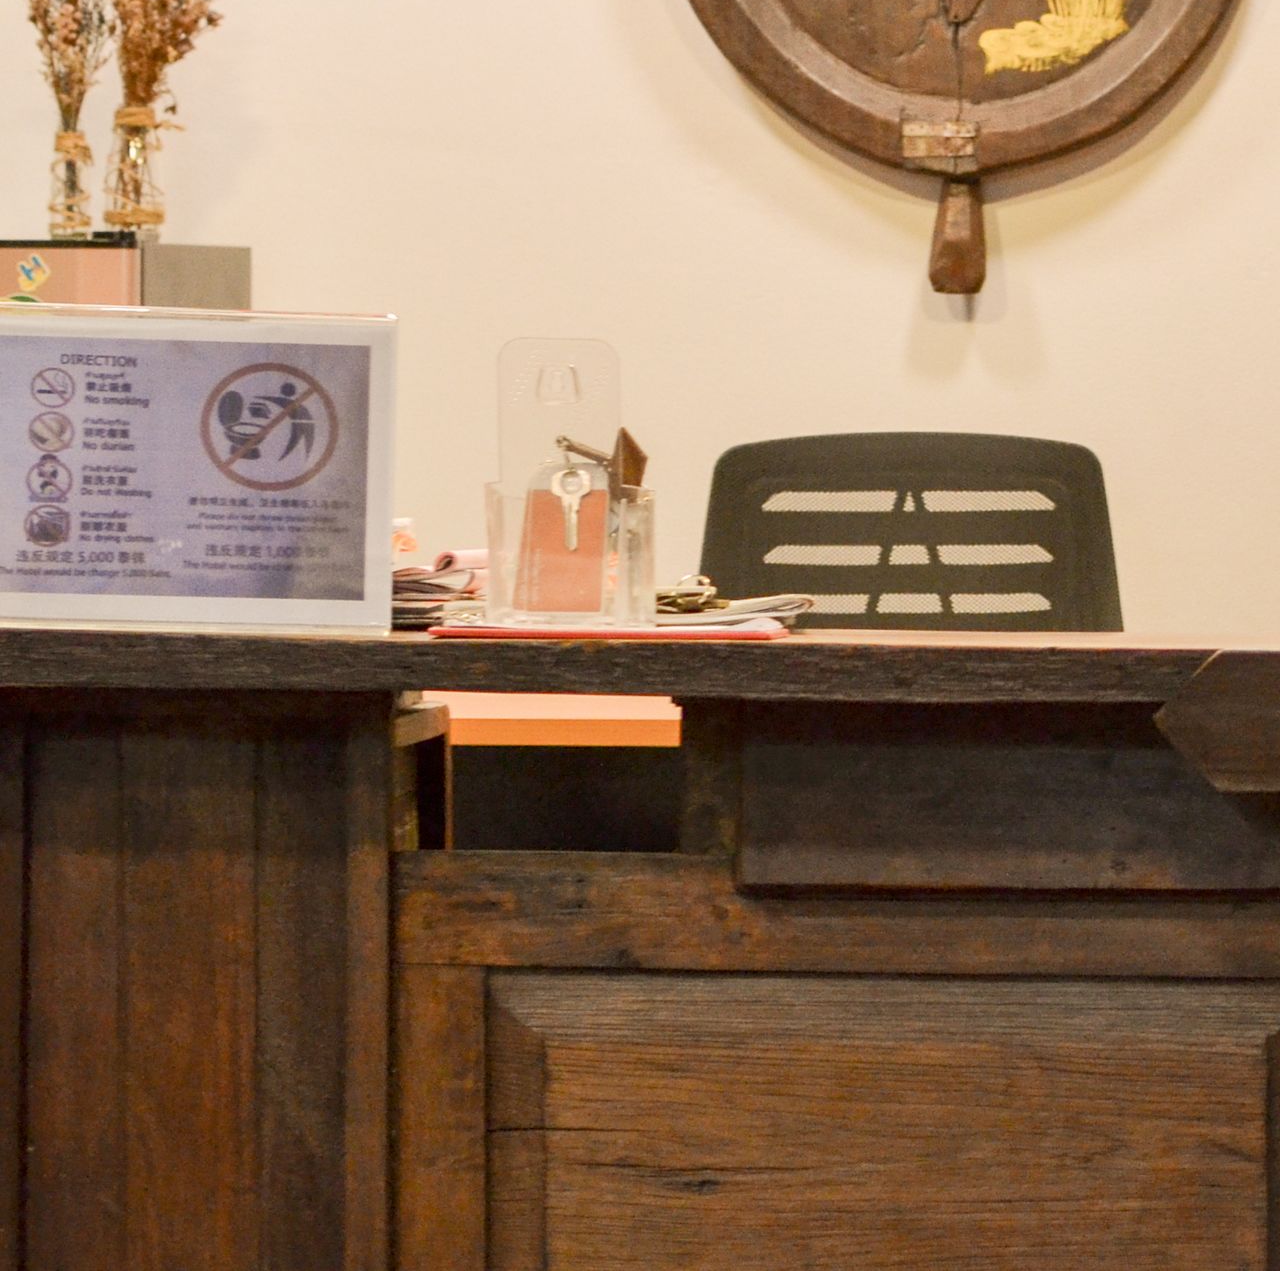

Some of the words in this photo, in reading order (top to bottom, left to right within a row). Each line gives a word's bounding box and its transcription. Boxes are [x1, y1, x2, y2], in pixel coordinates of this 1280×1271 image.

[60, 354, 137, 368] DIRECTION
[84, 396, 100, 405] No
[102, 397, 150, 409] smoking
[82, 442, 98, 450] No
[78, 551, 114, 564] 5,000
